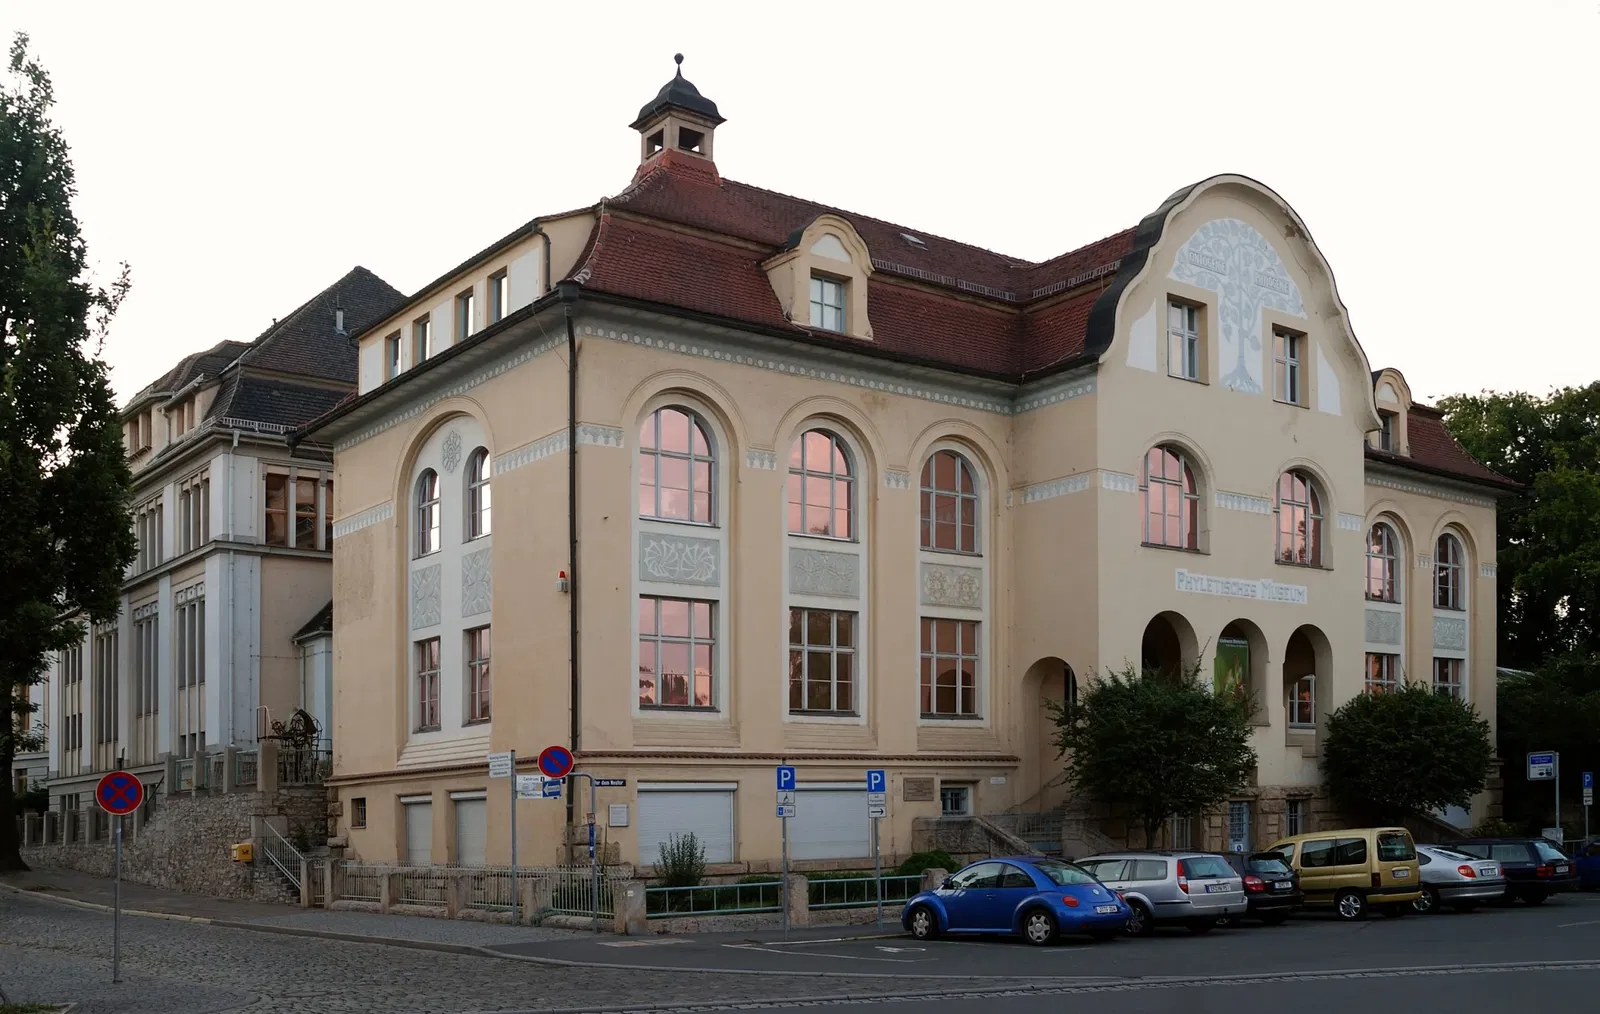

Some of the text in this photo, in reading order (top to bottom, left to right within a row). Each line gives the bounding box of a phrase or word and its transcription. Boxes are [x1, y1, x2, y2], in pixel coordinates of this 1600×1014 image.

[1177, 571, 1306, 603] PHYLETISCHES MUSEUM
[780, 769, 791, 787] P
[871, 773, 881, 790] P
[1585, 774, 1591, 786] P
